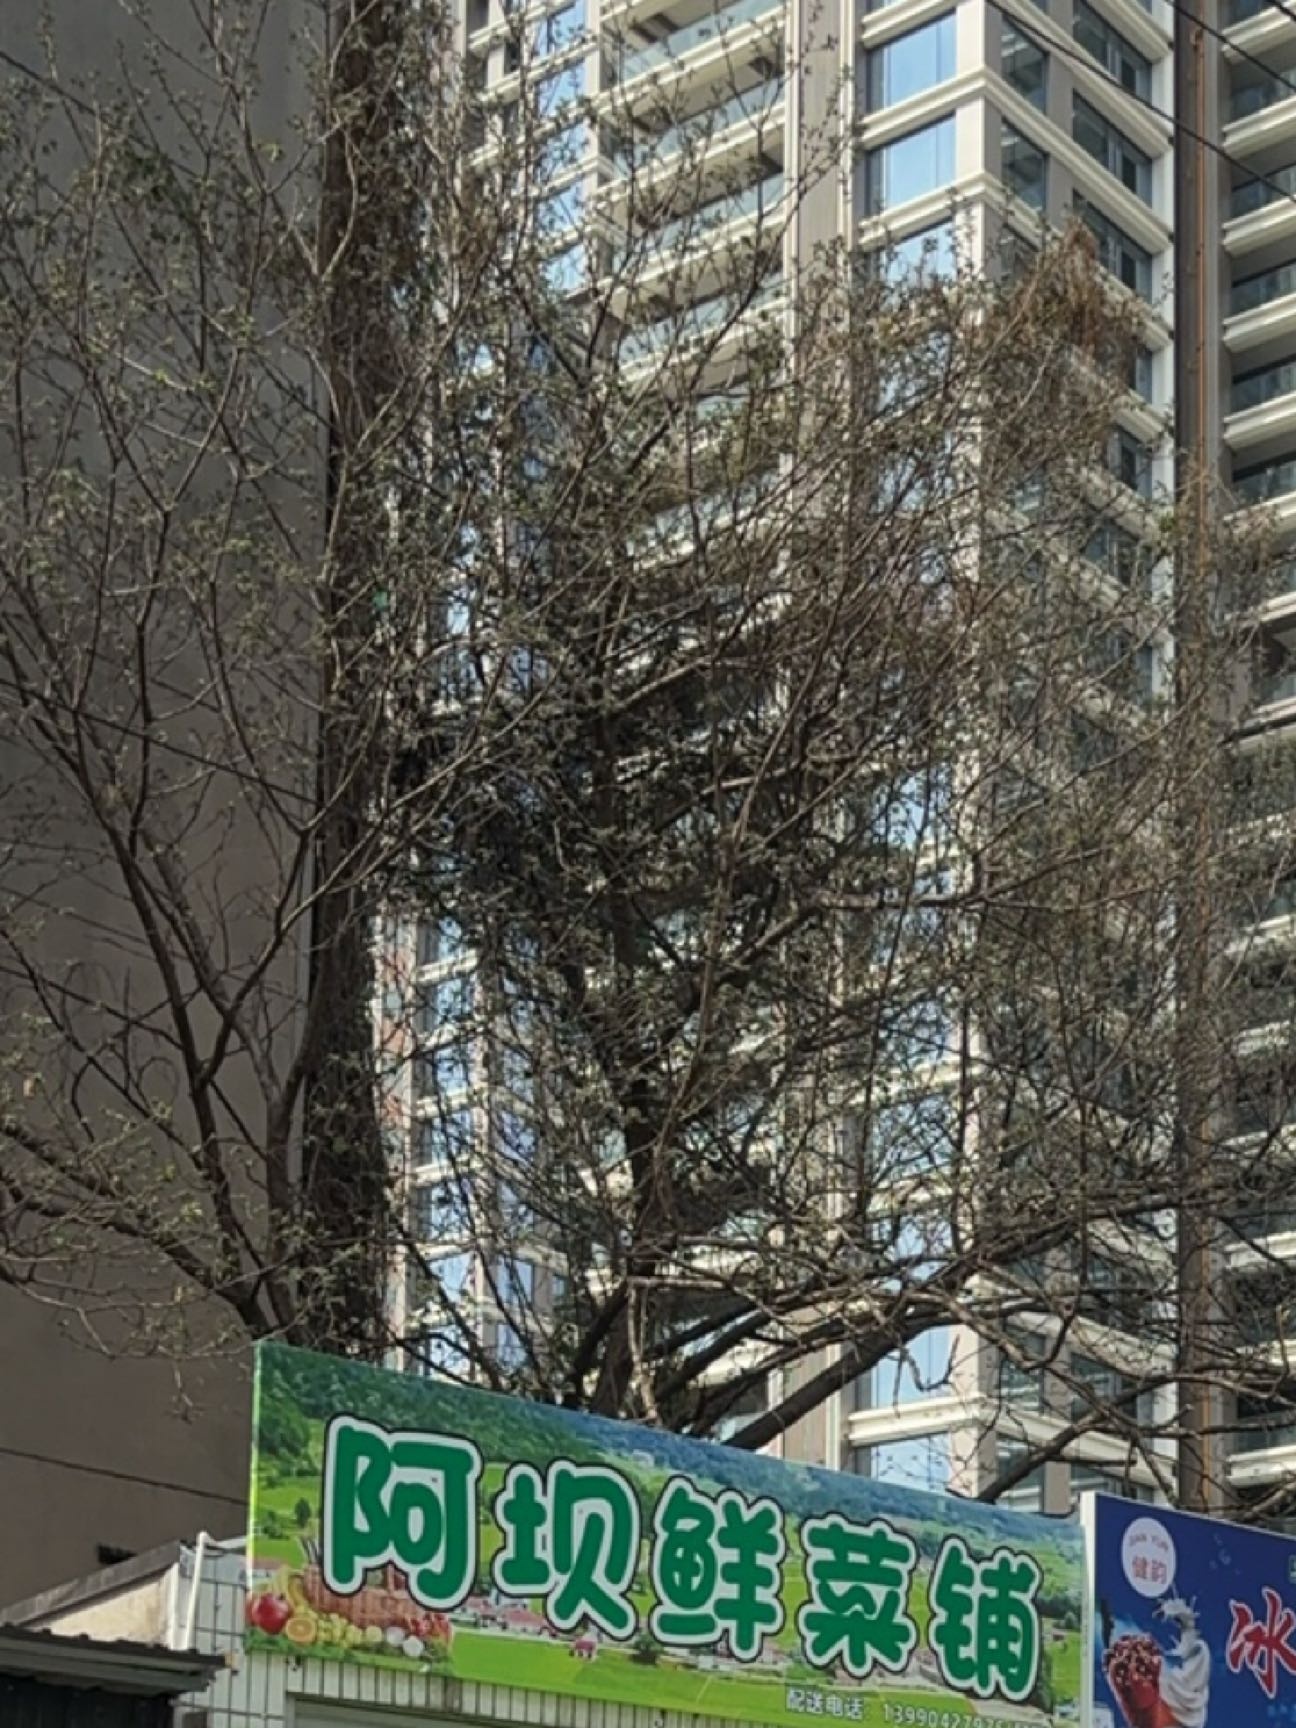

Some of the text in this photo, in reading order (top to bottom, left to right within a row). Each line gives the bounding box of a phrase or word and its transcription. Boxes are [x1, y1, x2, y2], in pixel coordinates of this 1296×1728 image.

[323, 1411, 1043, 1701] 阿坝鲜菜铺
